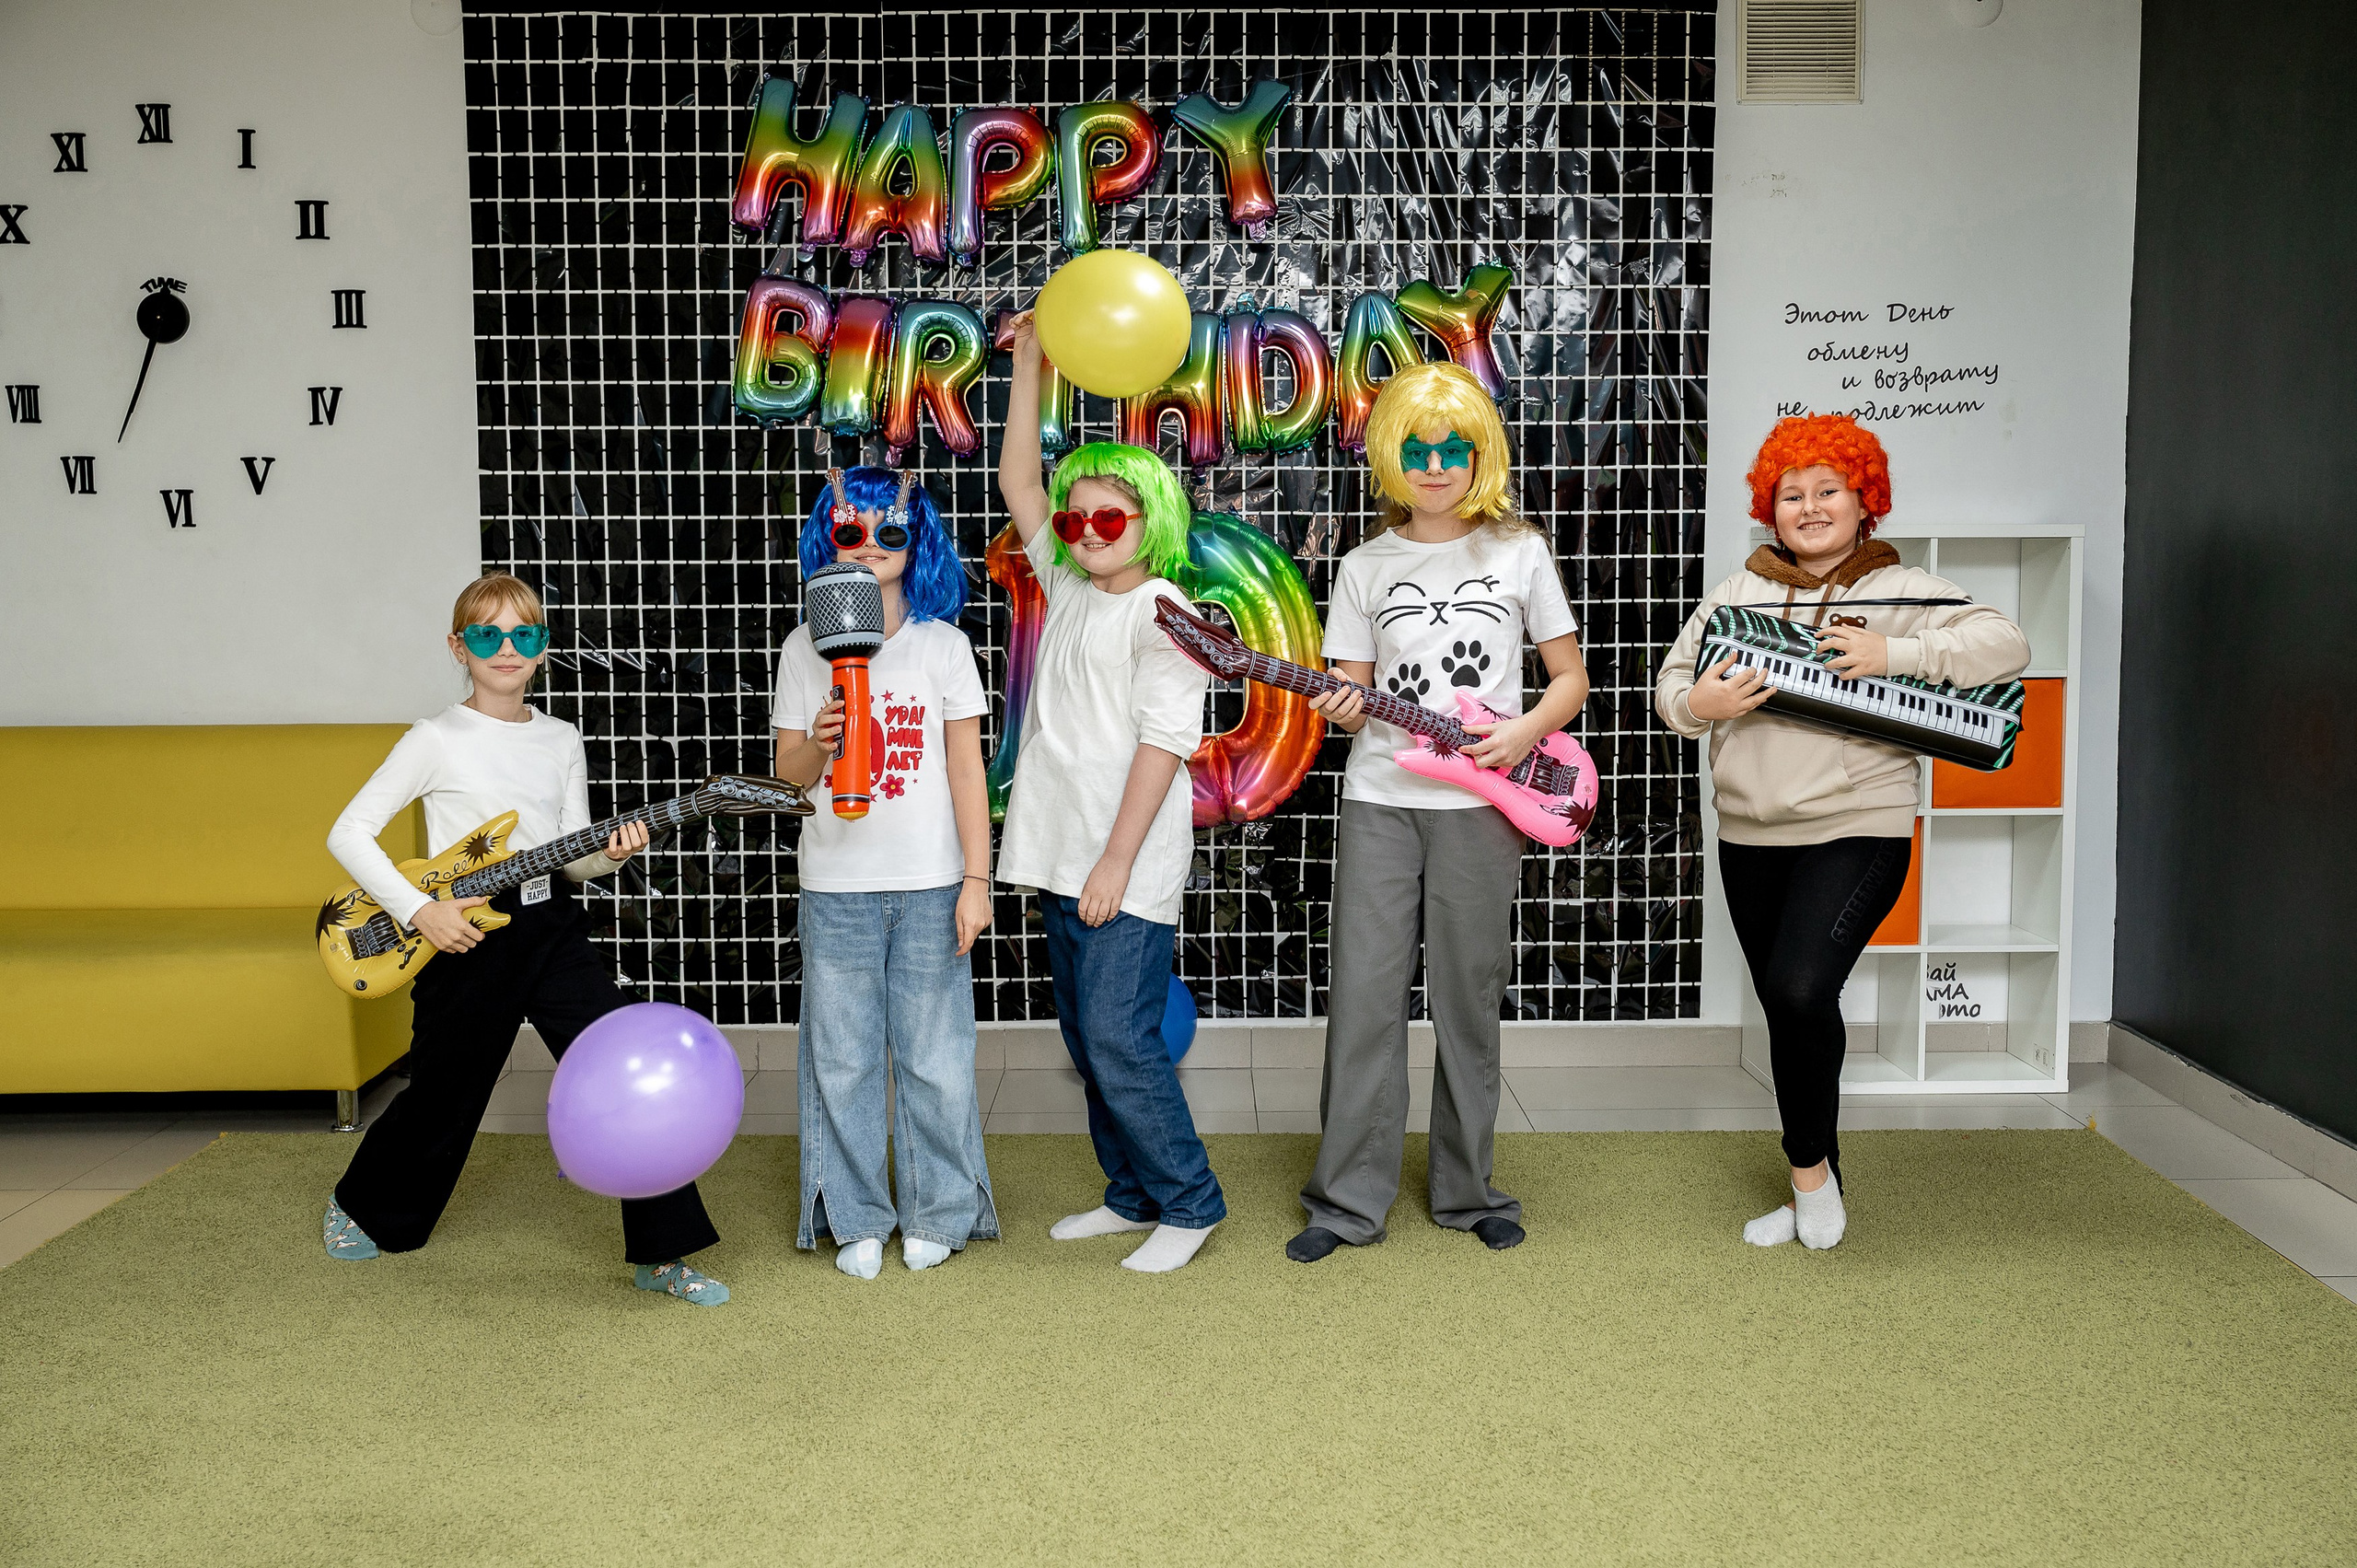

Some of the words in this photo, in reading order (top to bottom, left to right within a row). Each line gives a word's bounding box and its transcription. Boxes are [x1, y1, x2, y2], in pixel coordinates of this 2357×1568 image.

[135, 103, 173, 144] XII
[51, 133, 88, 173] XI
[238, 129, 257, 169] I
[733, 75, 1290, 265] HAPPY
[295, 200, 331, 240] II
[139, 276, 188, 294] TIME
[331, 290, 367, 329] III
[1784, 303, 1869, 324] Этот
[1887, 303, 1955, 322] День
[1807, 341, 1909, 363] обмену
[1842, 376, 1861, 389] и
[1875, 365, 1999, 392] возврату
[5, 385, 41, 424] VIII
[308, 387, 343, 425] IV
[1777, 401, 1808, 416] не
[60, 456, 97, 494] VII
[240, 457, 275, 494] V
[159, 489, 196, 528] VI
[885, 705, 925, 726] УРА!
[887, 726, 924, 749] МНЕ
[886, 750, 923, 771] ЛЕТ
[527, 888, 548, 901] HAPPY
[1927, 962, 1956, 981] ай
